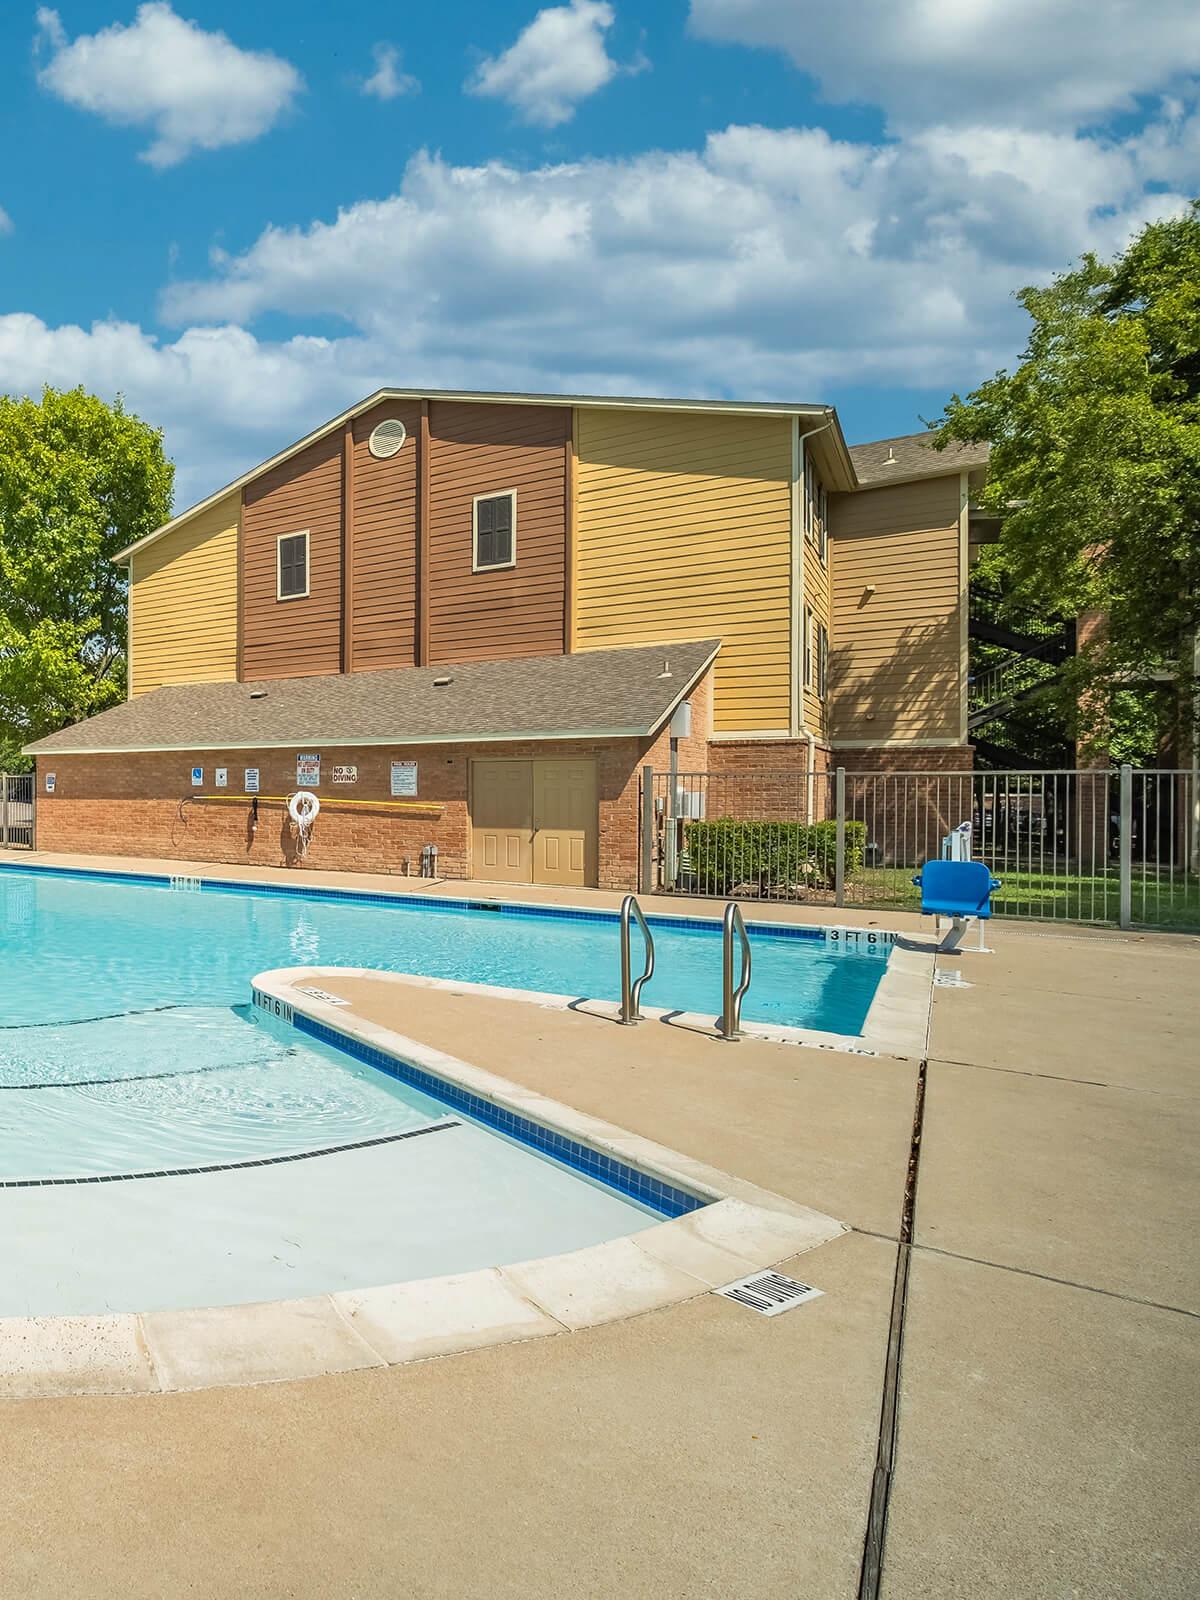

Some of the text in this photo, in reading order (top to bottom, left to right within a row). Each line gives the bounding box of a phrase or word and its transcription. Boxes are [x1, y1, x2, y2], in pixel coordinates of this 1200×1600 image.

[334, 774, 356, 782] DIVING
[831, 930, 899, 943] 3 FT 6 IN
[263, 995, 272, 1012] FT
[275, 1000, 280, 1016] 6
[283, 1004, 292, 1023] IN
[723, 1274, 812, 1312] NO DIVING
